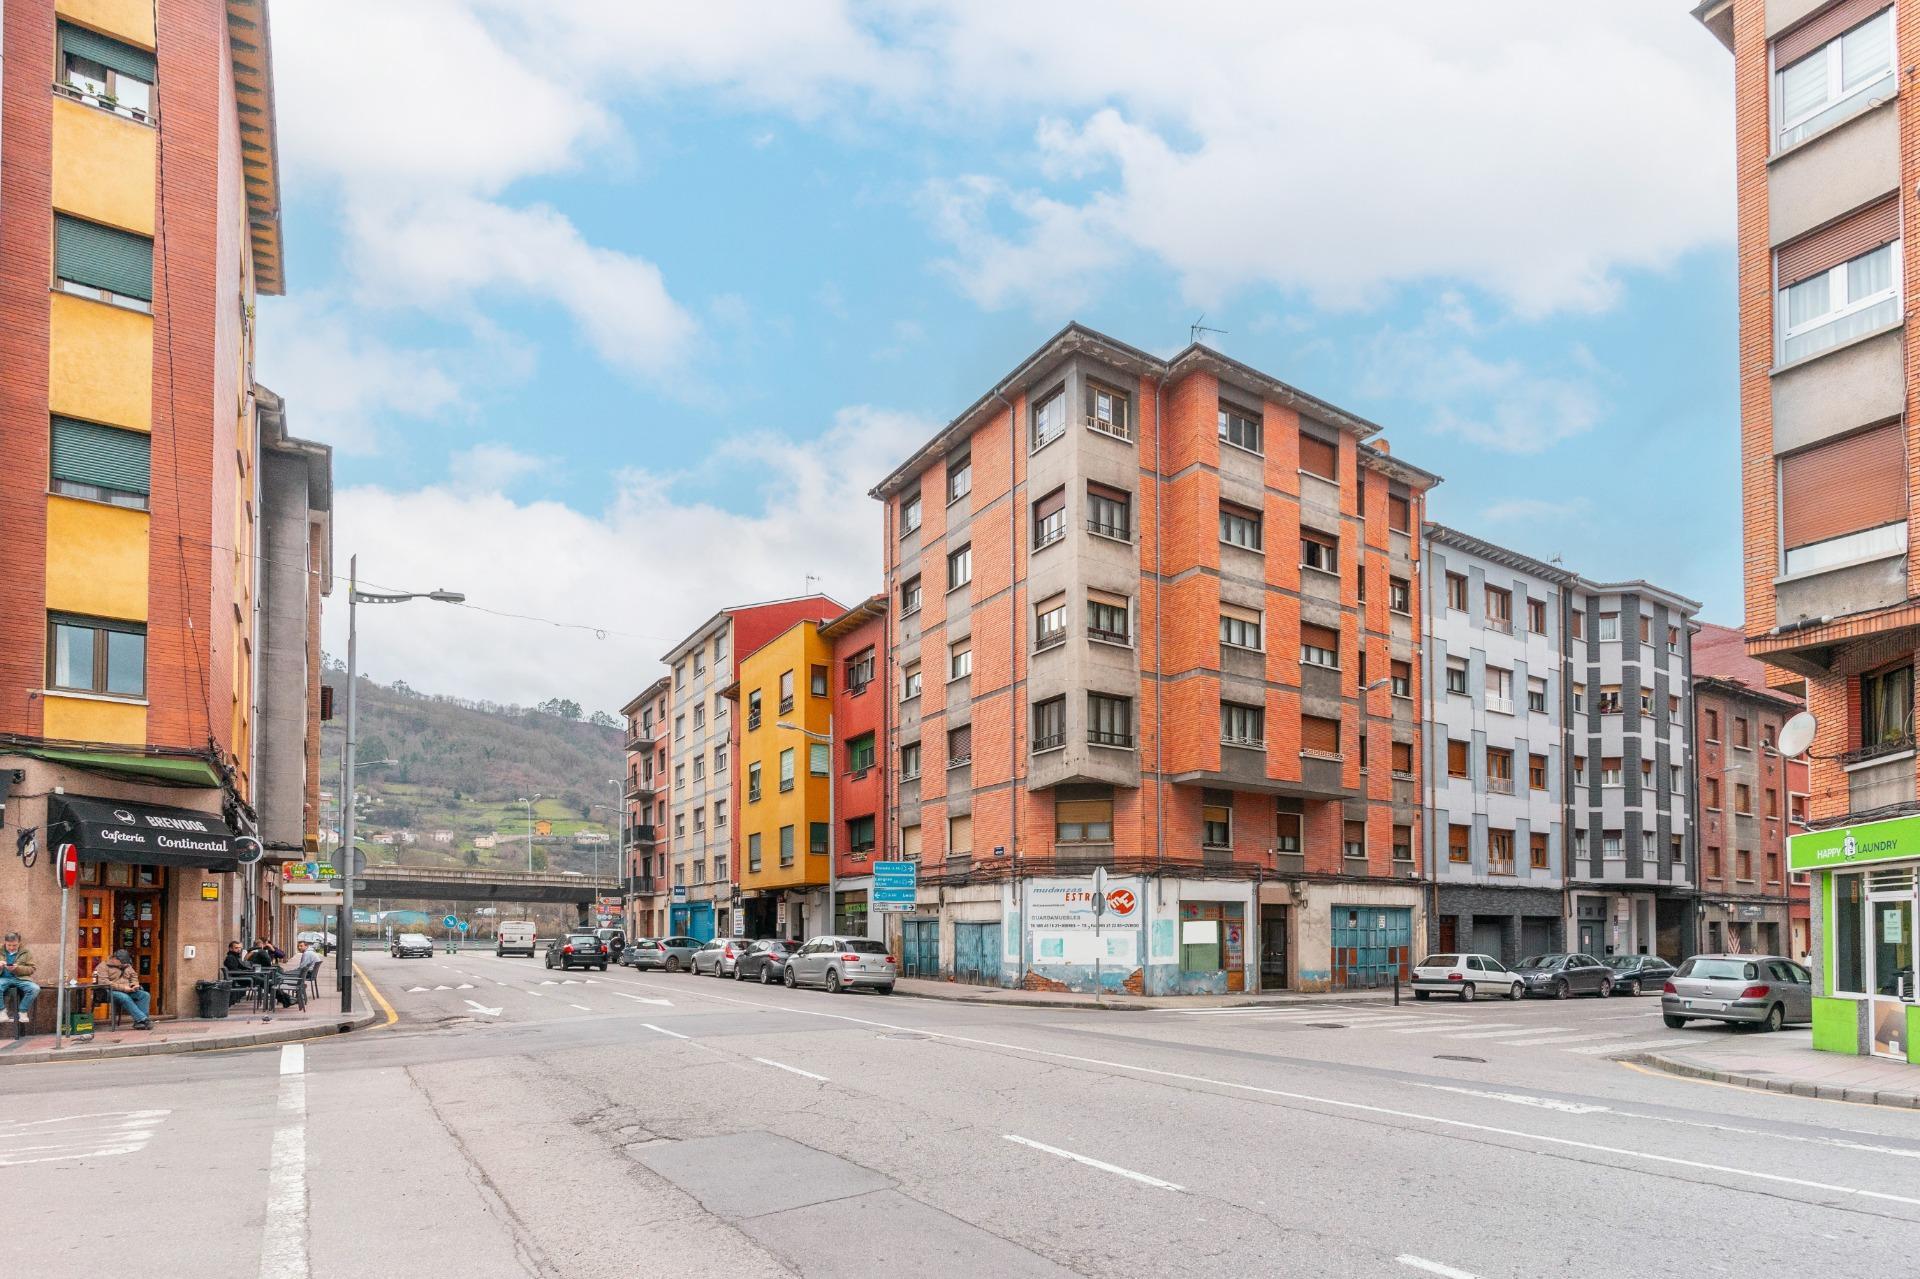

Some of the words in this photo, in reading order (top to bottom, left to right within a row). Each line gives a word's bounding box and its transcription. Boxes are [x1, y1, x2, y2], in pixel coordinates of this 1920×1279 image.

[145, 816, 208, 832] BREWDOG
[101, 829, 146, 843] Cafetería
[157, 835, 229, 852] Continental
[1816, 847, 1841, 860] HAPPY
[1857, 839, 1898, 854] LAUNDRY
[1065, 892, 1114, 902] ESTRA
